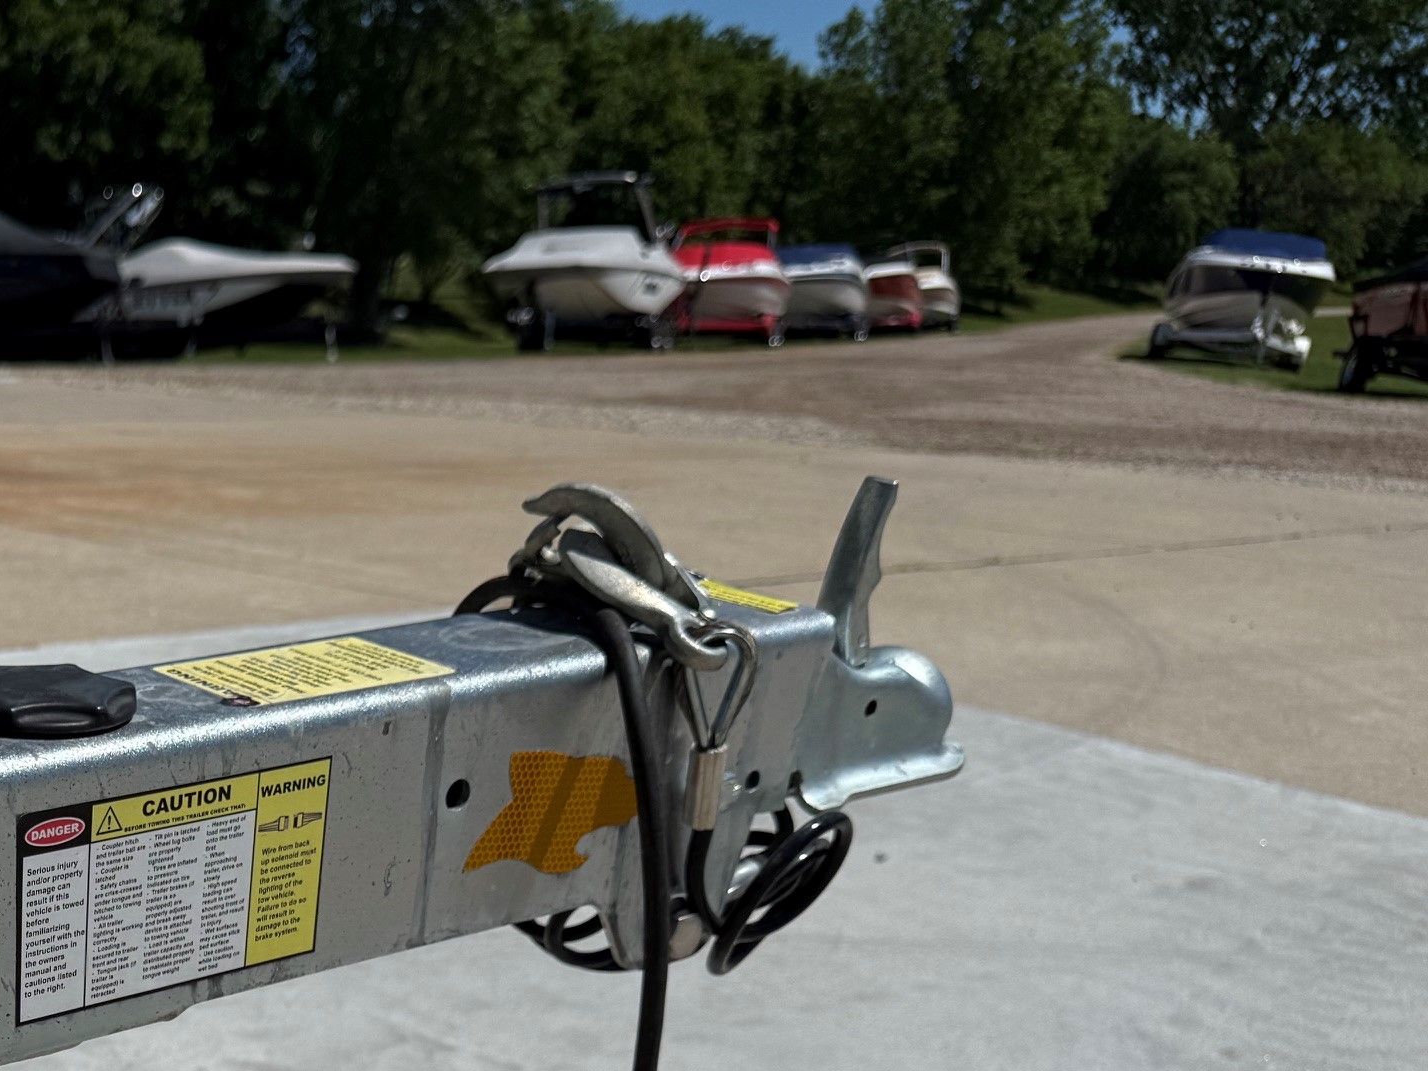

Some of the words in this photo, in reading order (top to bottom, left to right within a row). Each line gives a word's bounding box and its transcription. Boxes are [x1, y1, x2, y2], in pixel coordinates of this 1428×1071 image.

[261, 775, 326, 798] WARNING
[142, 785, 232, 817] CAUTION
[31, 823, 80, 841] DANGER
[27, 866, 55, 876] Serious
[57, 861, 78, 871] injury
[27, 877, 51, 887] and/or
[52, 870, 83, 884] property
[26, 886, 56, 897] damage
[57, 883, 71, 891] can
[26, 897, 48, 908] result
[49, 895, 54, 903] if
[56, 893, 69, 901] this
[26, 907, 52, 918] vehicle
[62, 899, 84, 910] towed
[26, 918, 49, 928] before
[26, 924, 70, 938] familiarizing
[25, 935, 55, 950] yourself
[57, 931, 72, 941] with
[26, 944, 68, 958] instructions
[25, 960, 37, 968] the
[38, 955, 65, 965] owners
[25, 966, 52, 978] manual
[53, 962, 67, 972] and
[25, 976, 56, 988] cautions
[58, 969, 77, 980] listed
[34, 988, 45, 996] the
[47, 983, 65, 993] right.
